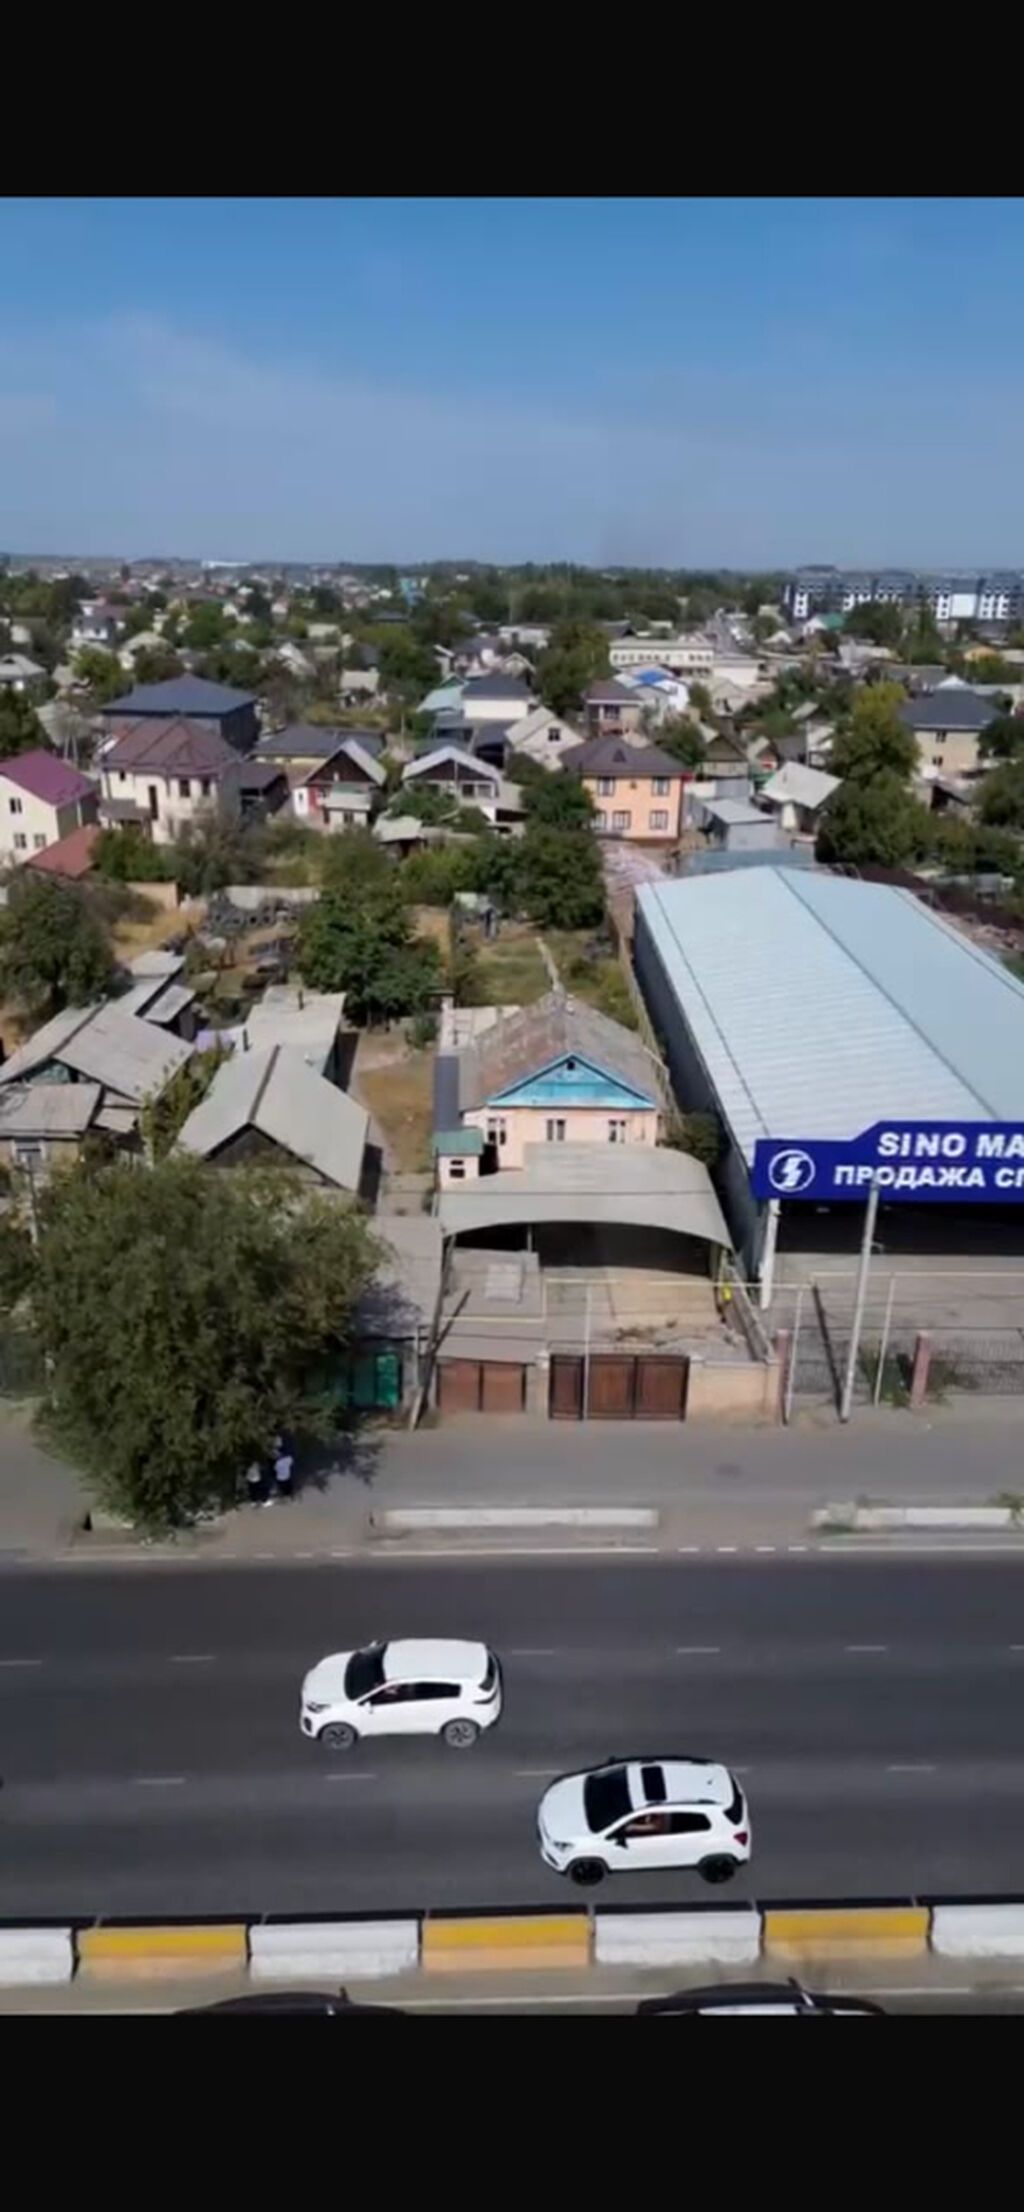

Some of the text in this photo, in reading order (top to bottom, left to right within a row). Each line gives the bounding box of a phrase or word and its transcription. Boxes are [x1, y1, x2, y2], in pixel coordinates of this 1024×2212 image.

[877, 1132, 1024, 1158] SINO MA
[834, 1165, 986, 1189] ПРОДАЖА
